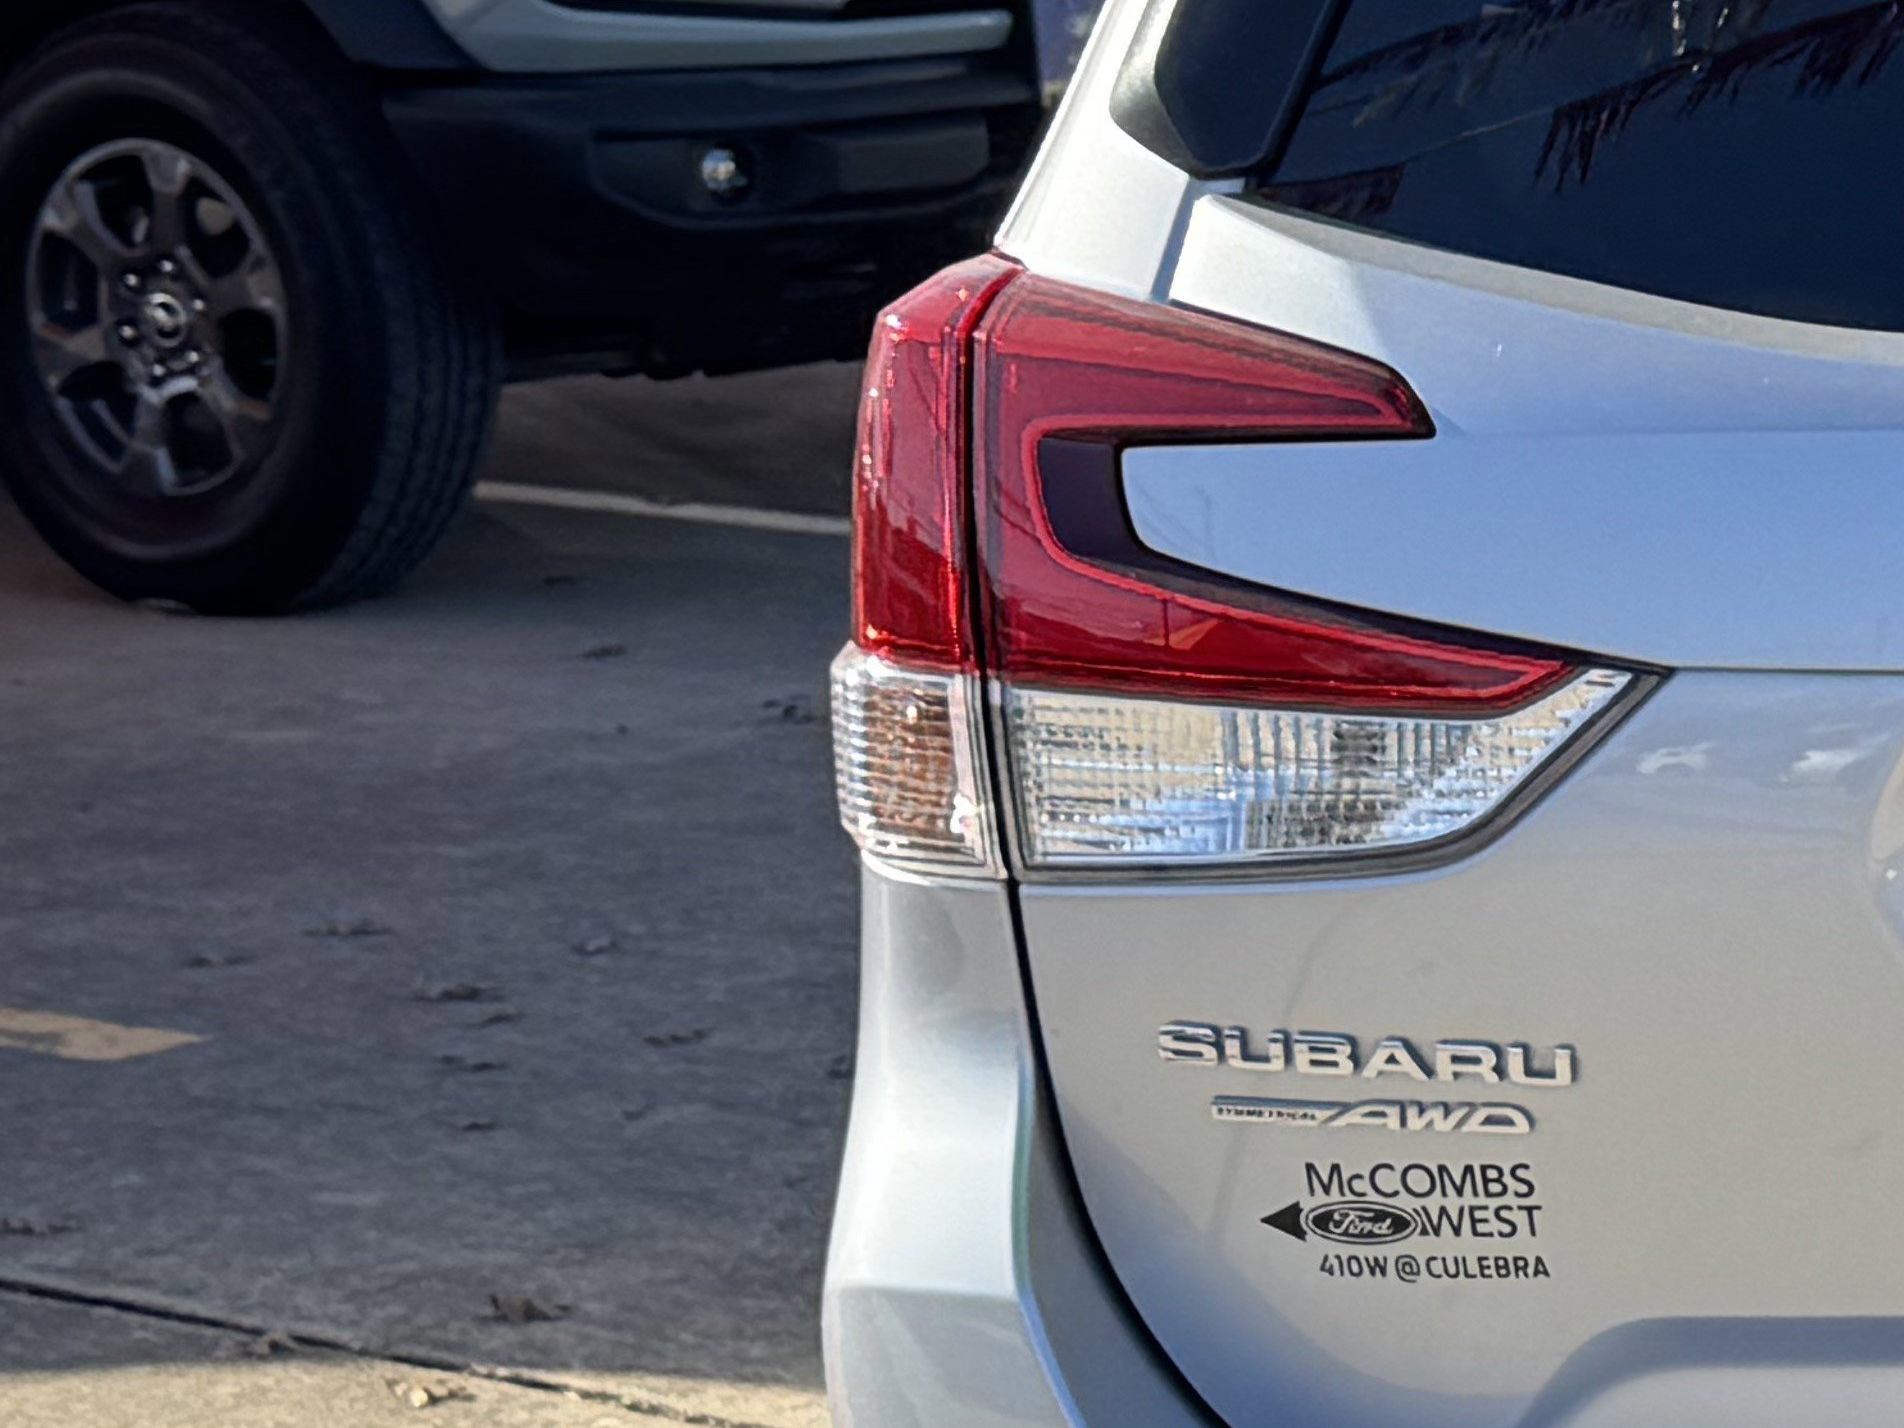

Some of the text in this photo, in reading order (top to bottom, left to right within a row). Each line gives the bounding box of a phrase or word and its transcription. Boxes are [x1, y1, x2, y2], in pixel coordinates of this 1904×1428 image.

[1157, 1020, 1577, 1088] SUBARU
[1327, 1098, 1533, 1134] AWD
[1305, 1161, 1536, 1198] McCOMBS
[1419, 1204, 1543, 1238] WEST
[1425, 1255, 1551, 1278] CULEBRA
